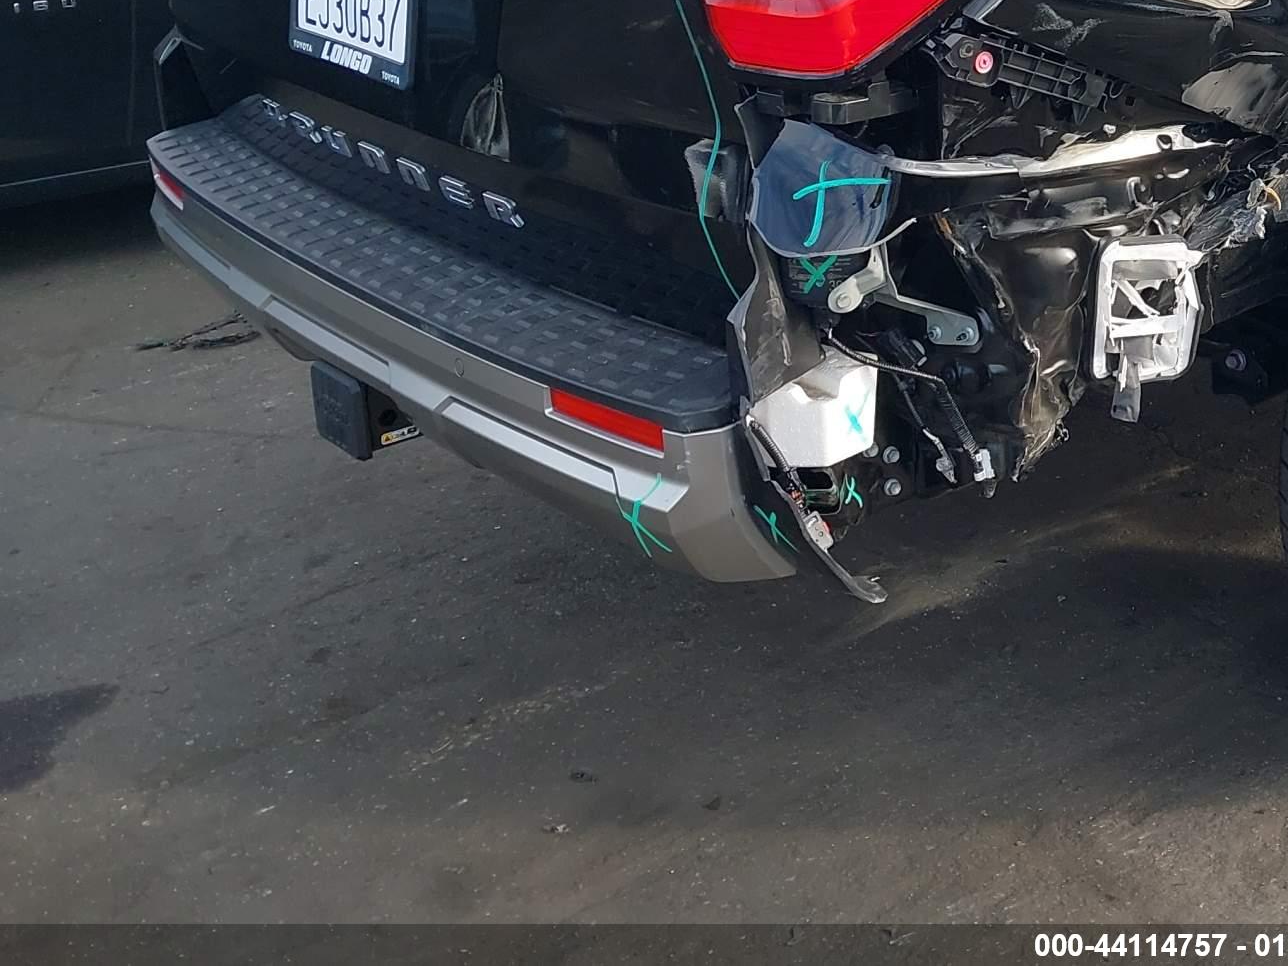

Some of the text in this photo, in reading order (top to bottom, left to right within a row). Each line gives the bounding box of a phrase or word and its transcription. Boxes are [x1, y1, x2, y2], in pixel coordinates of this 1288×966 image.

[293, 39, 313, 53] TOYOTA
[320, 40, 373, 75] LONGO
[381, 70, 400, 86] TOYOTA
[262, 98, 525, 228] 4RUNNER
